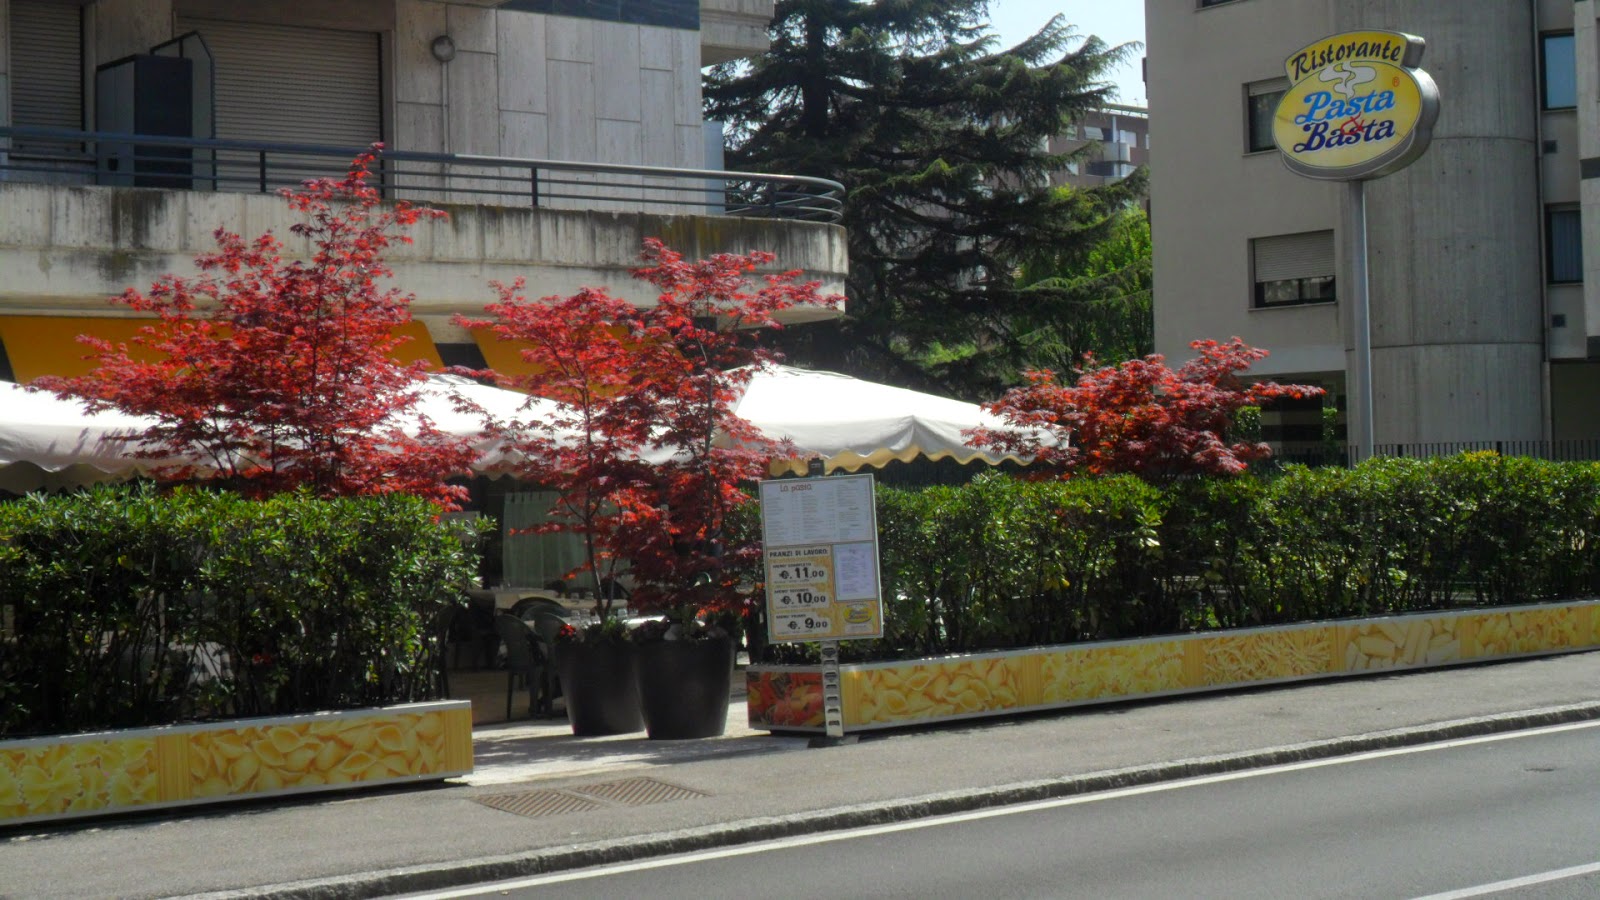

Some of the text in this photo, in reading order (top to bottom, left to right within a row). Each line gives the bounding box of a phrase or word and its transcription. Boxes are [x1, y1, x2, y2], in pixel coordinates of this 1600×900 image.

[1291, 40, 1401, 81] Ristorante
[1294, 90, 1396, 125] Pasta
[1340, 112, 1365, 136] &
[1293, 119, 1396, 153] Basta
